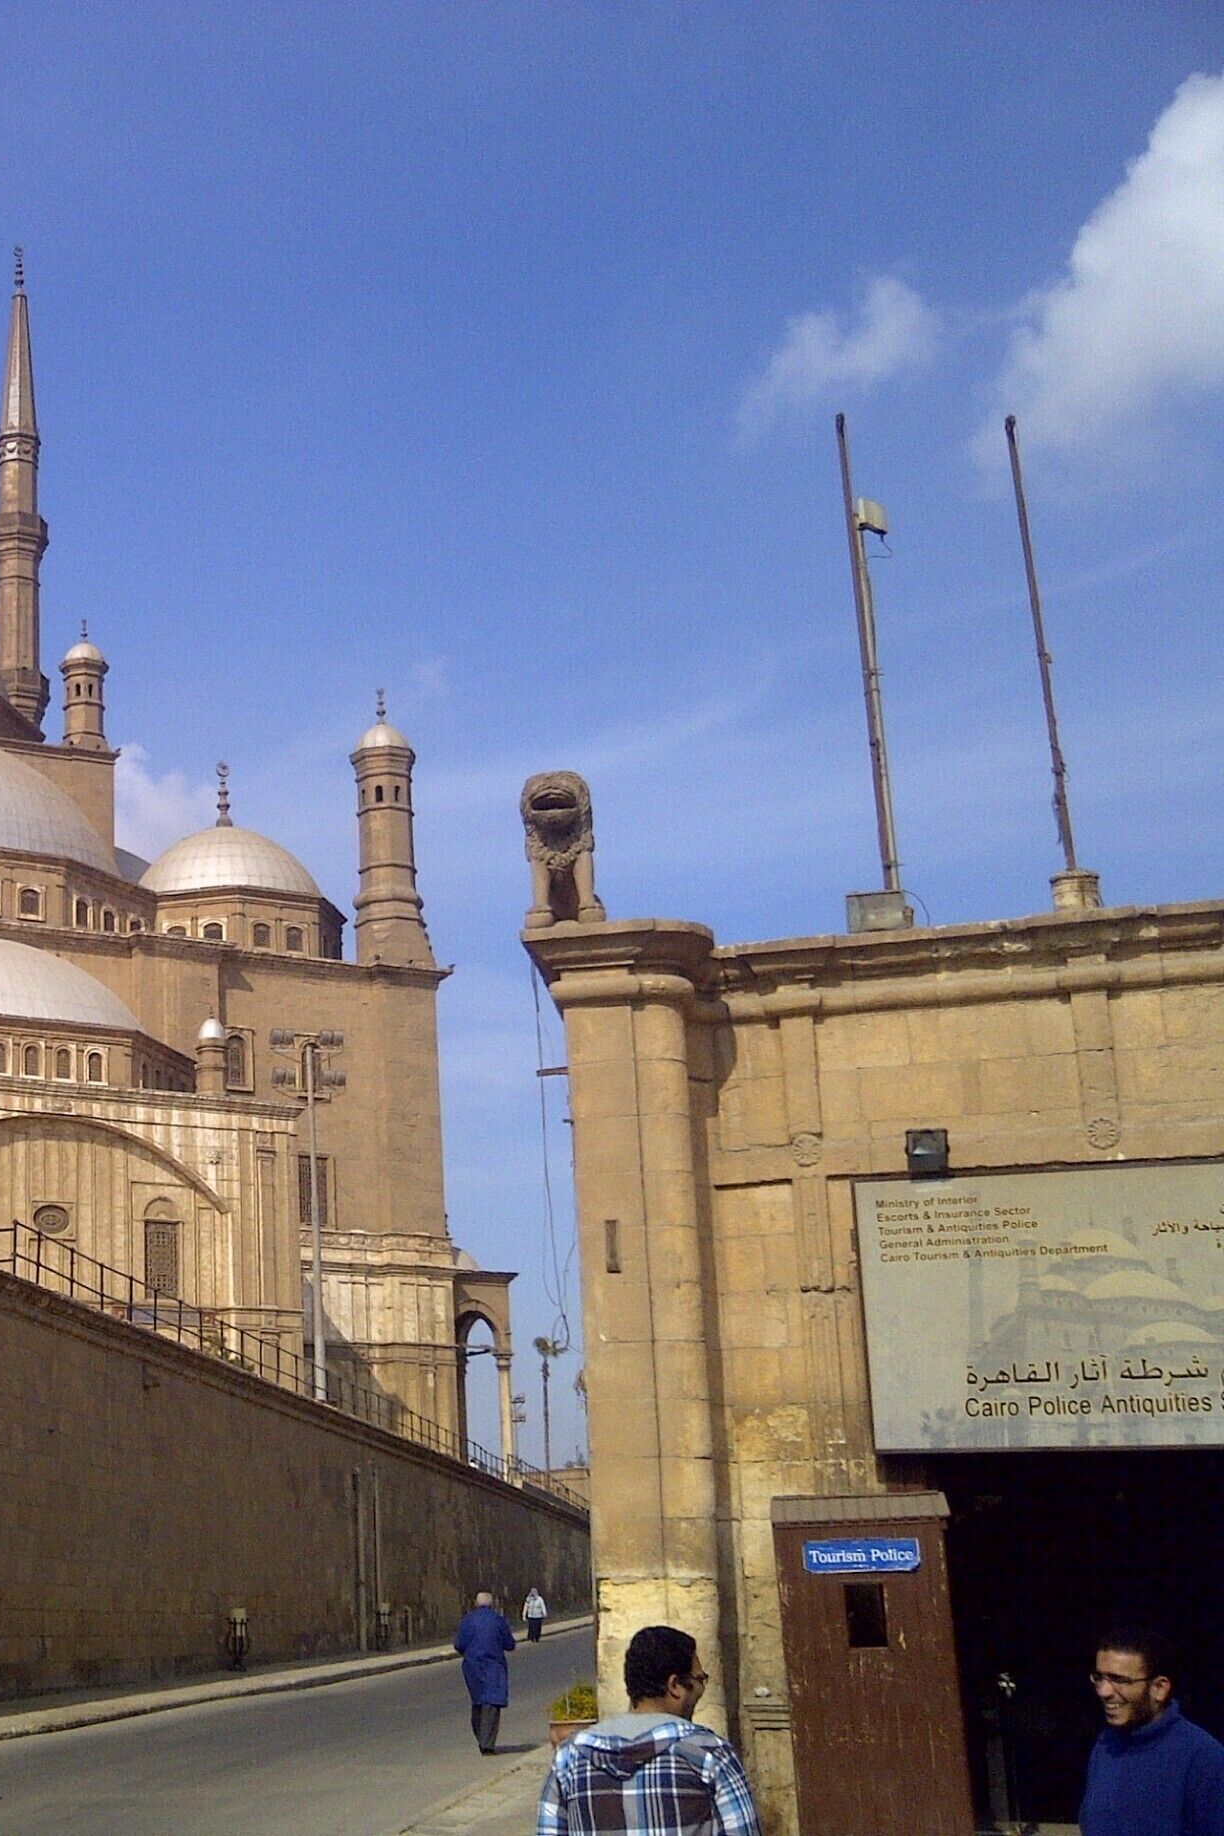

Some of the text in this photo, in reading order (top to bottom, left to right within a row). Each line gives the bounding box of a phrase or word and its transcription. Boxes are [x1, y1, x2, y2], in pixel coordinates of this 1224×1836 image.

[875, 1196, 978, 1209] Ministry of Interior
[877, 1207, 1031, 1222] Escorts & Insurance Sector
[878, 1220, 1038, 1236] Tourism & Antiquities Police
[879, 1235, 1009, 1249] General Administration
[880, 1244, 1108, 1263] Cairo Tourism & Antiquities Department
[966, 1361, 1060, 1391] القاهرة
[1069, 1354, 1107, 1389] آثار
[1120, 1355, 1209, 1387] شرطة
[965, 1397, 1020, 1417] Cairo
[1028, 1395, 1091, 1416] Police
[1101, 1392, 1213, 1418] Antiquities
[809, 1548, 915, 1563] Tourism Police
